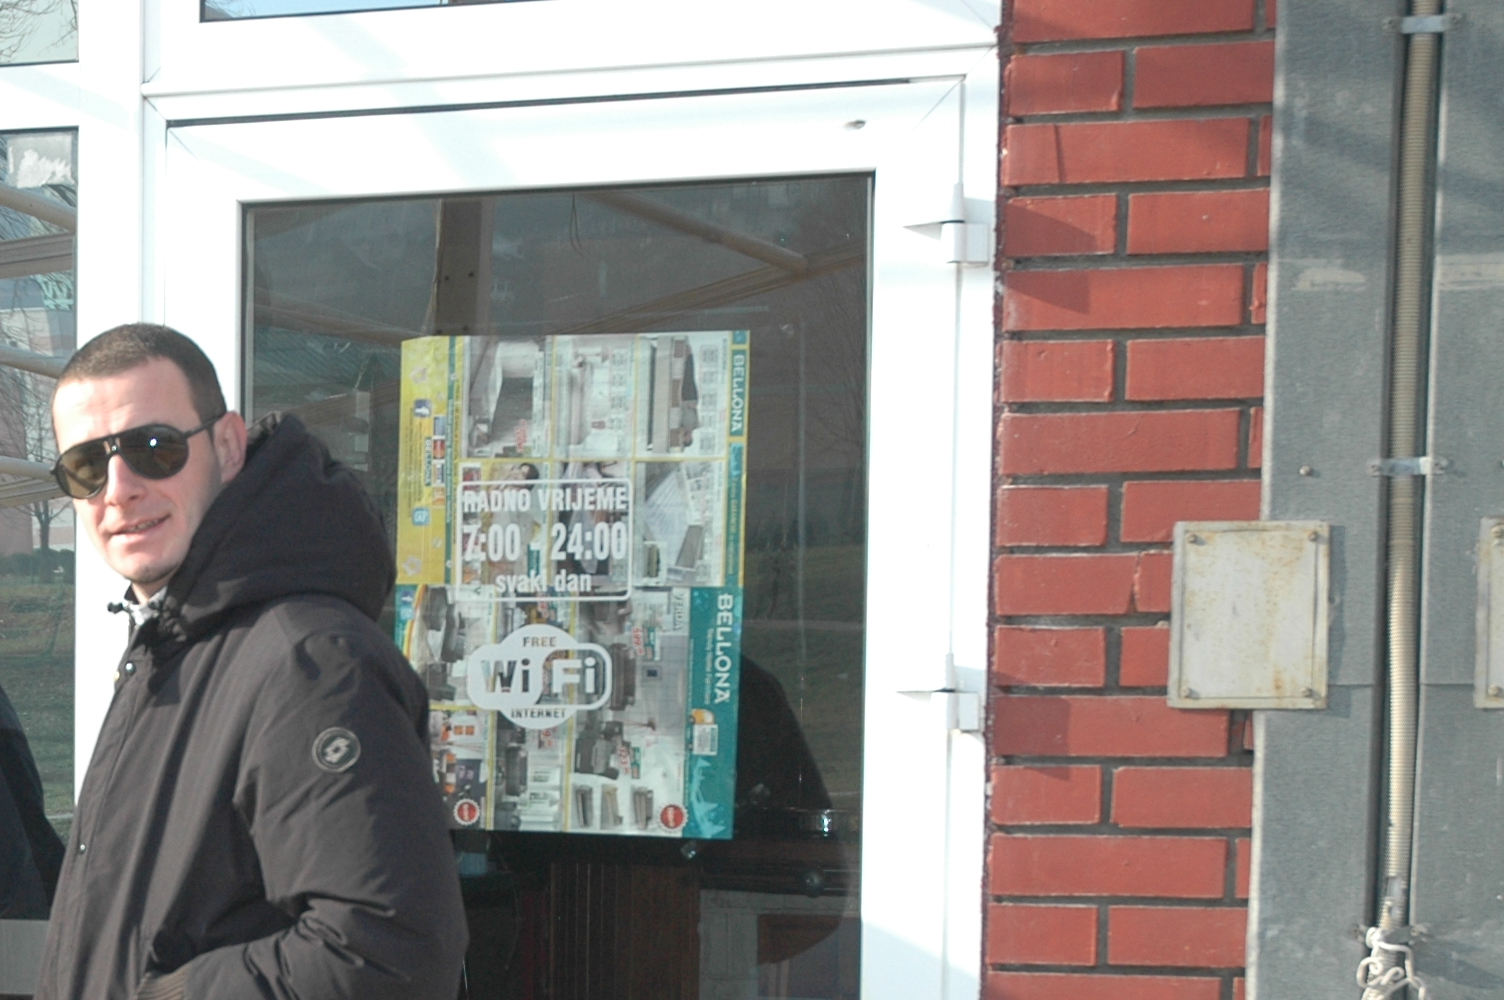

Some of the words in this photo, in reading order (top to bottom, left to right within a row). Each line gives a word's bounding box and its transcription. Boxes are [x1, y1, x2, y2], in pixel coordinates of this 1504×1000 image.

[730, 354, 745, 432] BELLONA
[463, 489, 531, 512] RADNO
[538, 487, 627, 511] VRIJEME
[463, 523, 521, 562] 7:00
[551, 521, 629, 561] 24:00
[496, 569, 546, 593] svaki
[554, 568, 592, 592] dan
[522, 636, 557, 647] FREE
[714, 593, 733, 704] BELLONA
[511, 708, 567, 719] INTERNET
